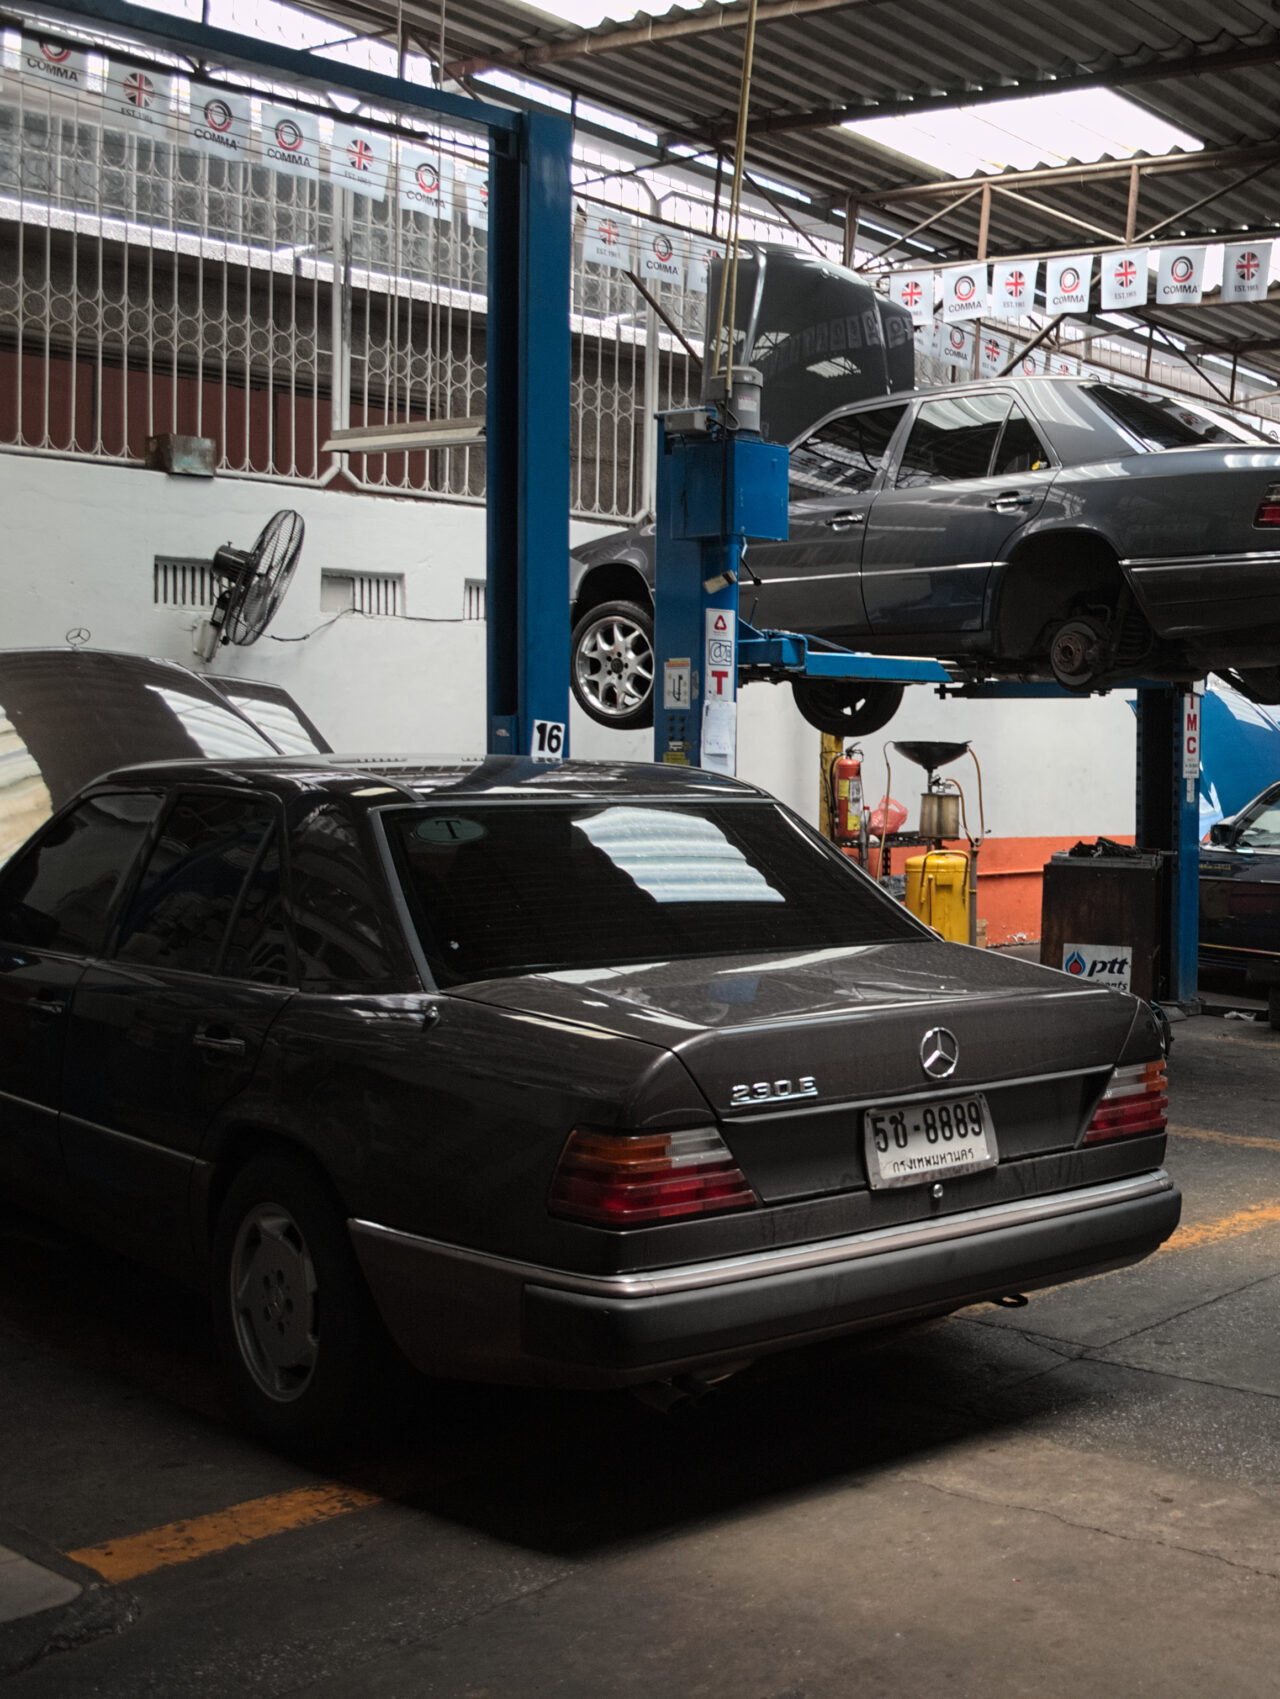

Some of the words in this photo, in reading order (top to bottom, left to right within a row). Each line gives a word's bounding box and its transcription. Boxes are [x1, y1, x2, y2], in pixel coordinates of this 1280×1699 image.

[27, 58, 79, 82] COMMA
[194, 128, 238, 151] COMMA
[267, 148, 311, 168] COMMA
[646, 260, 679, 276] COMMA
[1163, 284, 1198, 295] COMMA
[949, 301, 983, 313] COMMA
[1053, 294, 1085, 306] COMMA
[536, 723, 562, 753] 16
[1087, 957, 1128, 977] ptt
[732, 1080, 792, 1102] 230
[799, 1076, 817, 1093] E
